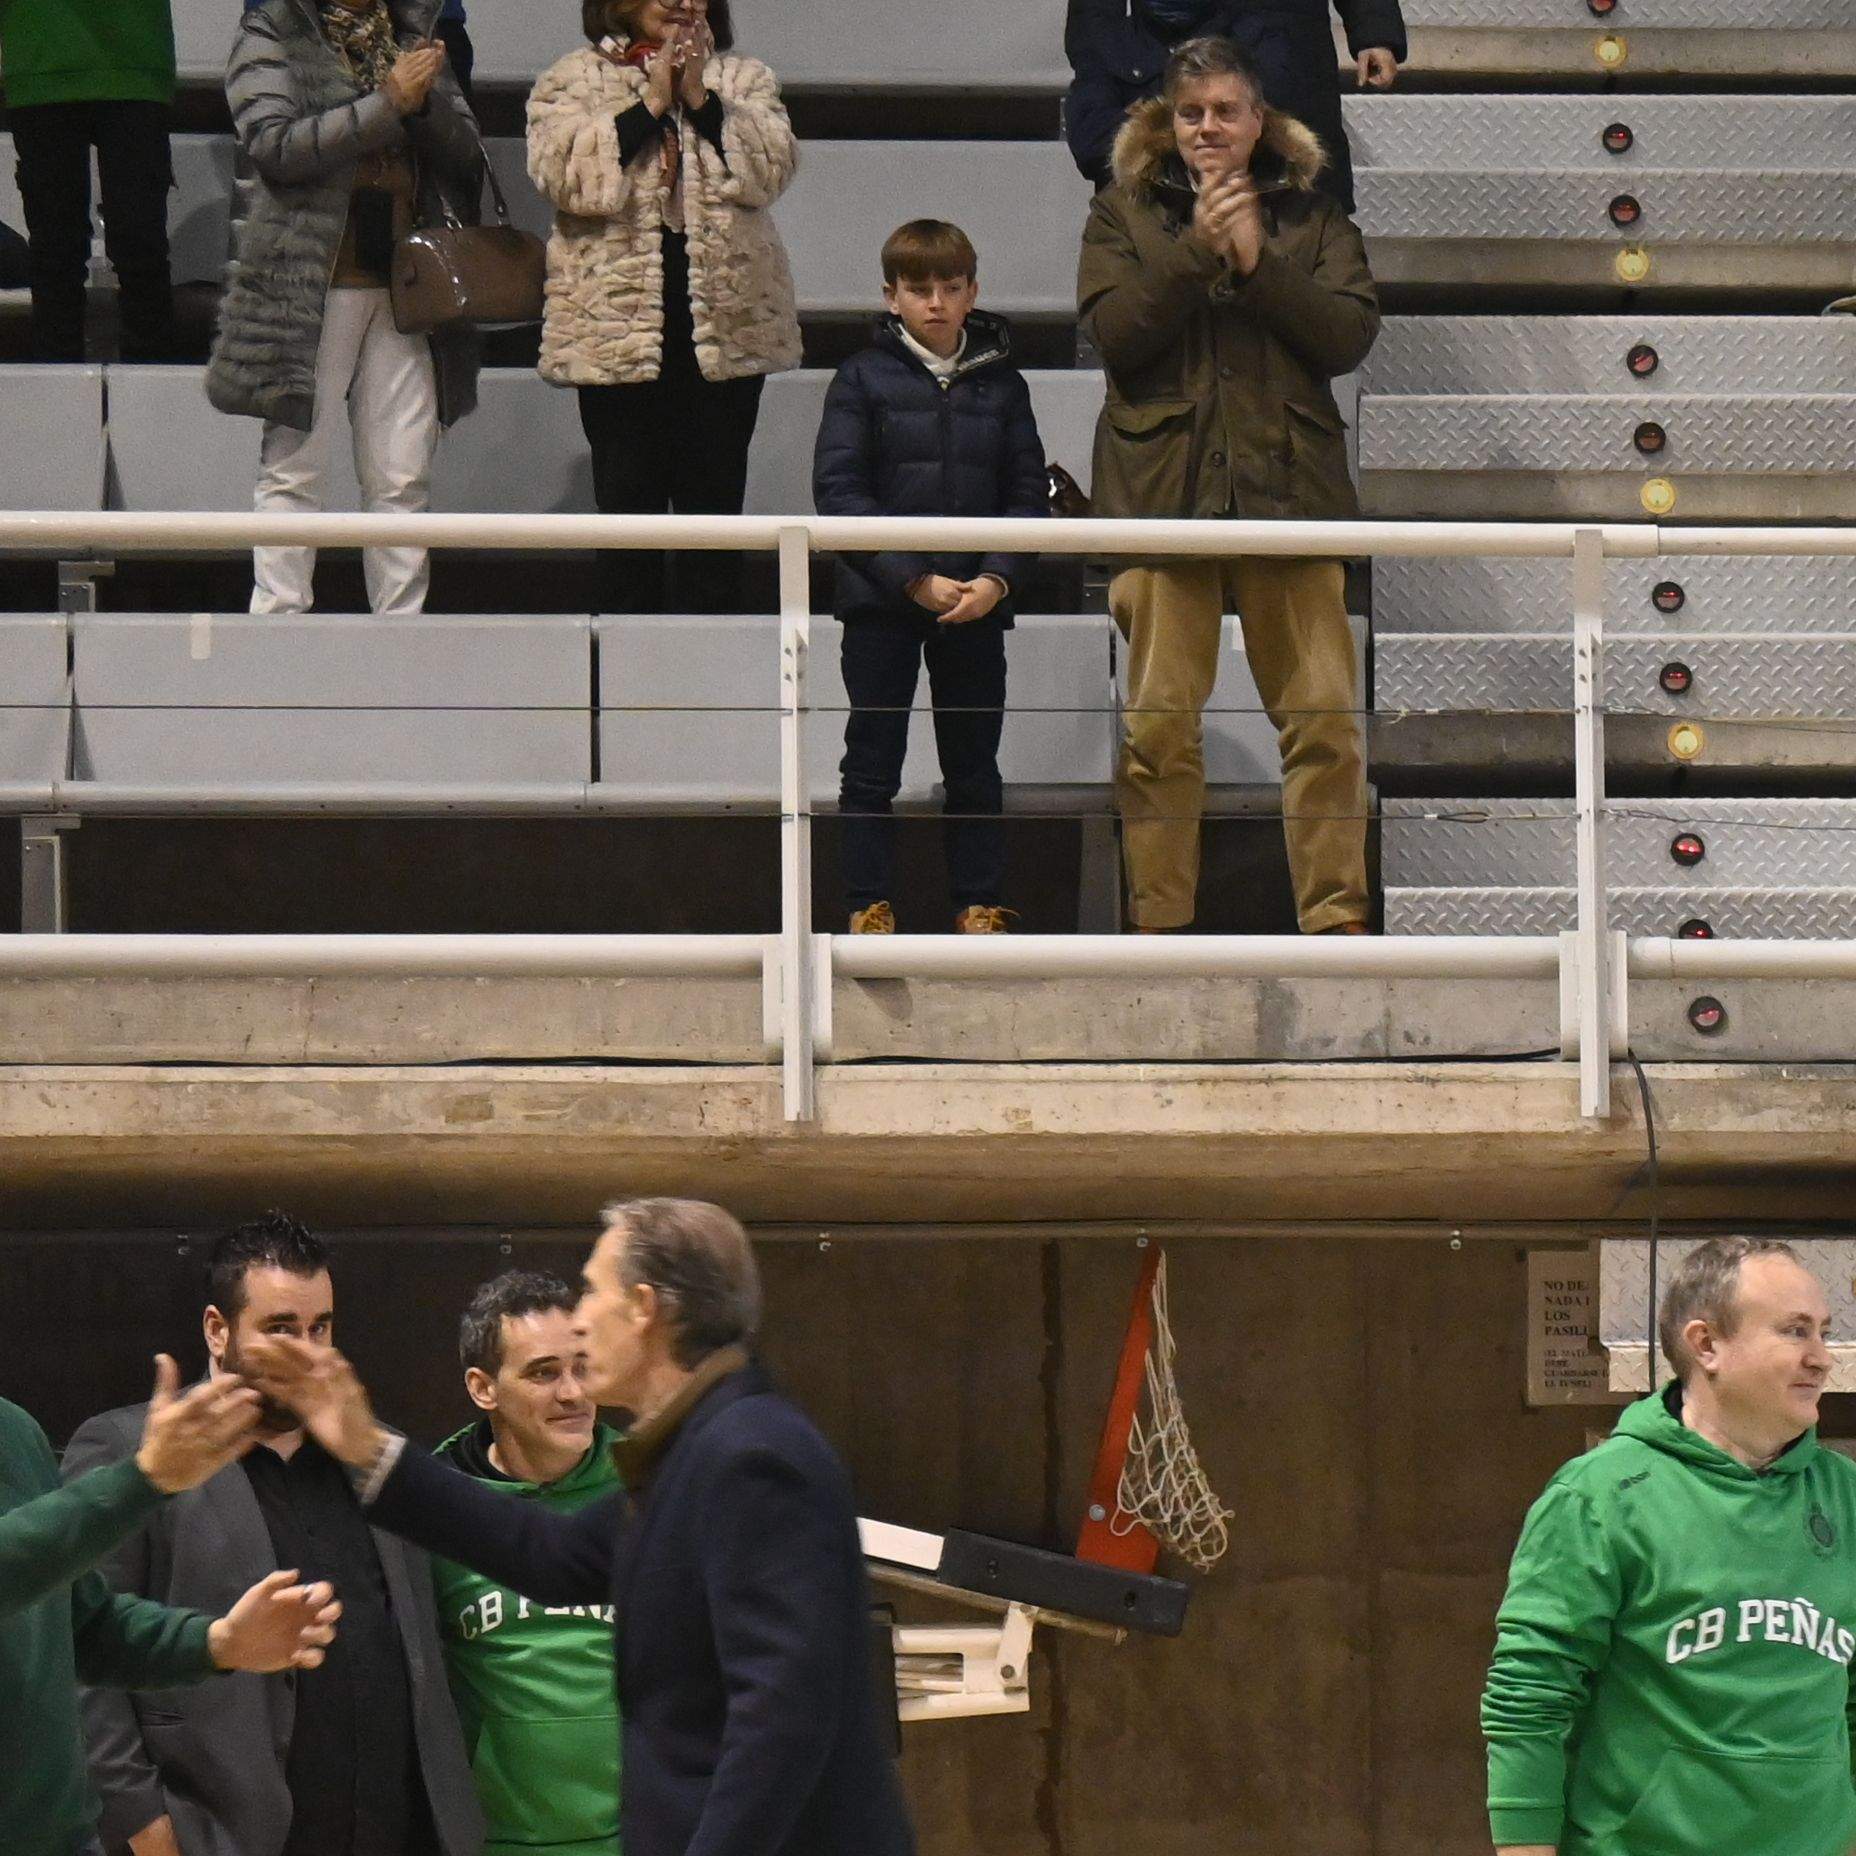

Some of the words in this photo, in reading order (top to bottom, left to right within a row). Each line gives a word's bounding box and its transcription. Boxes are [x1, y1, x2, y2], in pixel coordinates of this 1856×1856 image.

[1544, 1280, 1564, 1291] NO
[1545, 1311, 1570, 1321] LOS
[460, 1591, 502, 1640] CB
[1666, 1607, 1726, 1664] CB
[1736, 1597, 1856, 1665] PEÑAS
